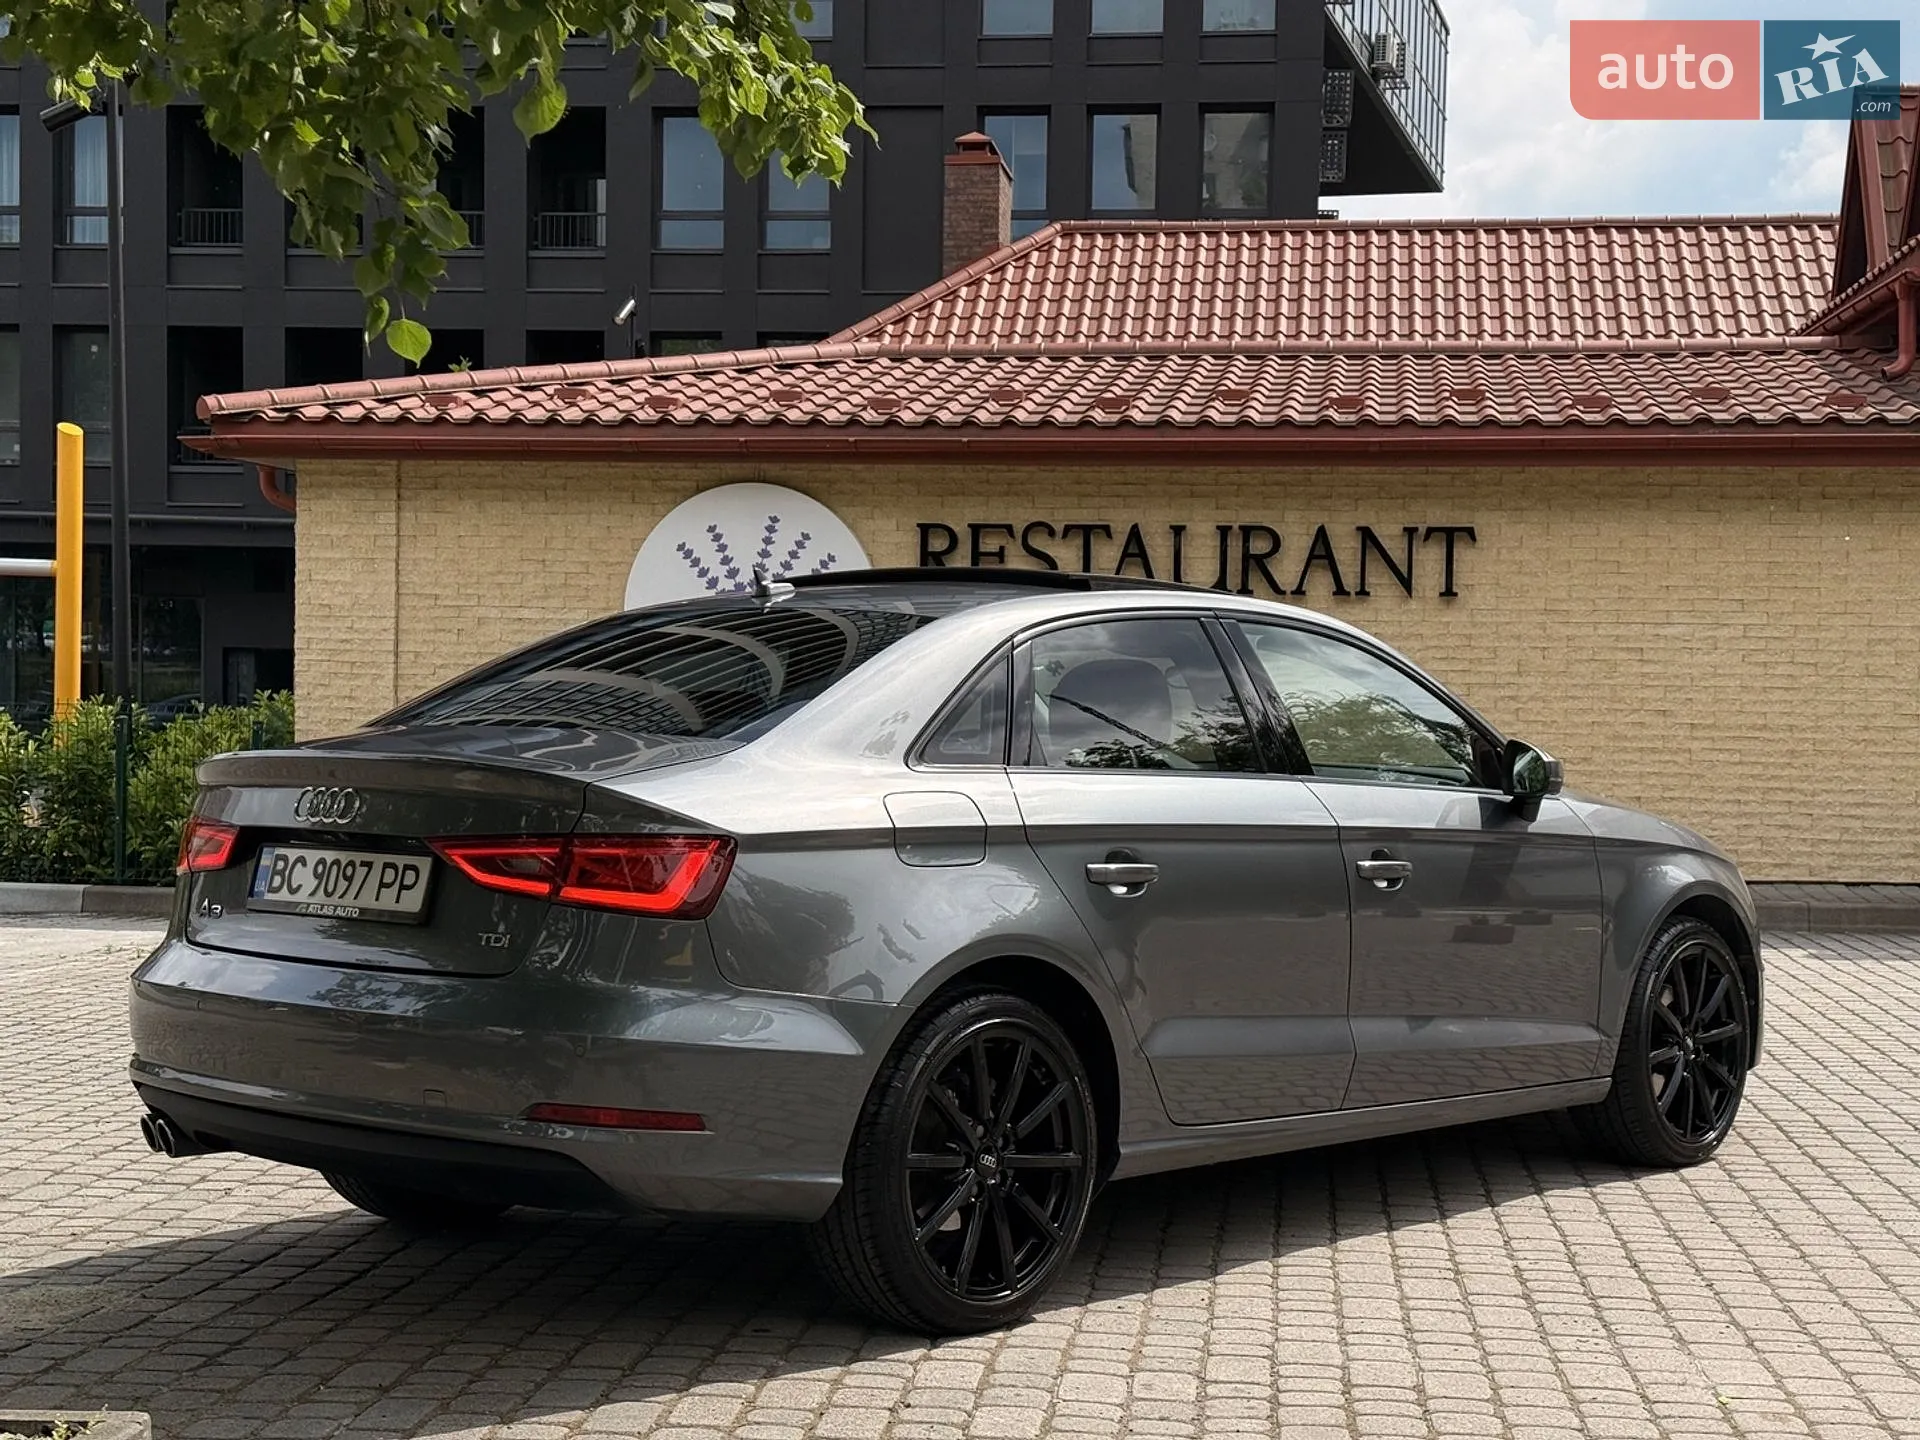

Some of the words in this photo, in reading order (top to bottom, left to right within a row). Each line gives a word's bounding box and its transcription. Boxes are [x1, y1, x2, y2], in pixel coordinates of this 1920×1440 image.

[916, 520, 1477, 598] RESTAURANT
[266, 853, 307, 895] BC
[308, 857, 374, 900] 9097
[374, 861, 420, 904] PP
[199, 897, 223, 919] A3
[307, 903, 335, 916] ATLAS
[335, 906, 359, 918] AUTO
[478, 932, 511, 948] TDI
